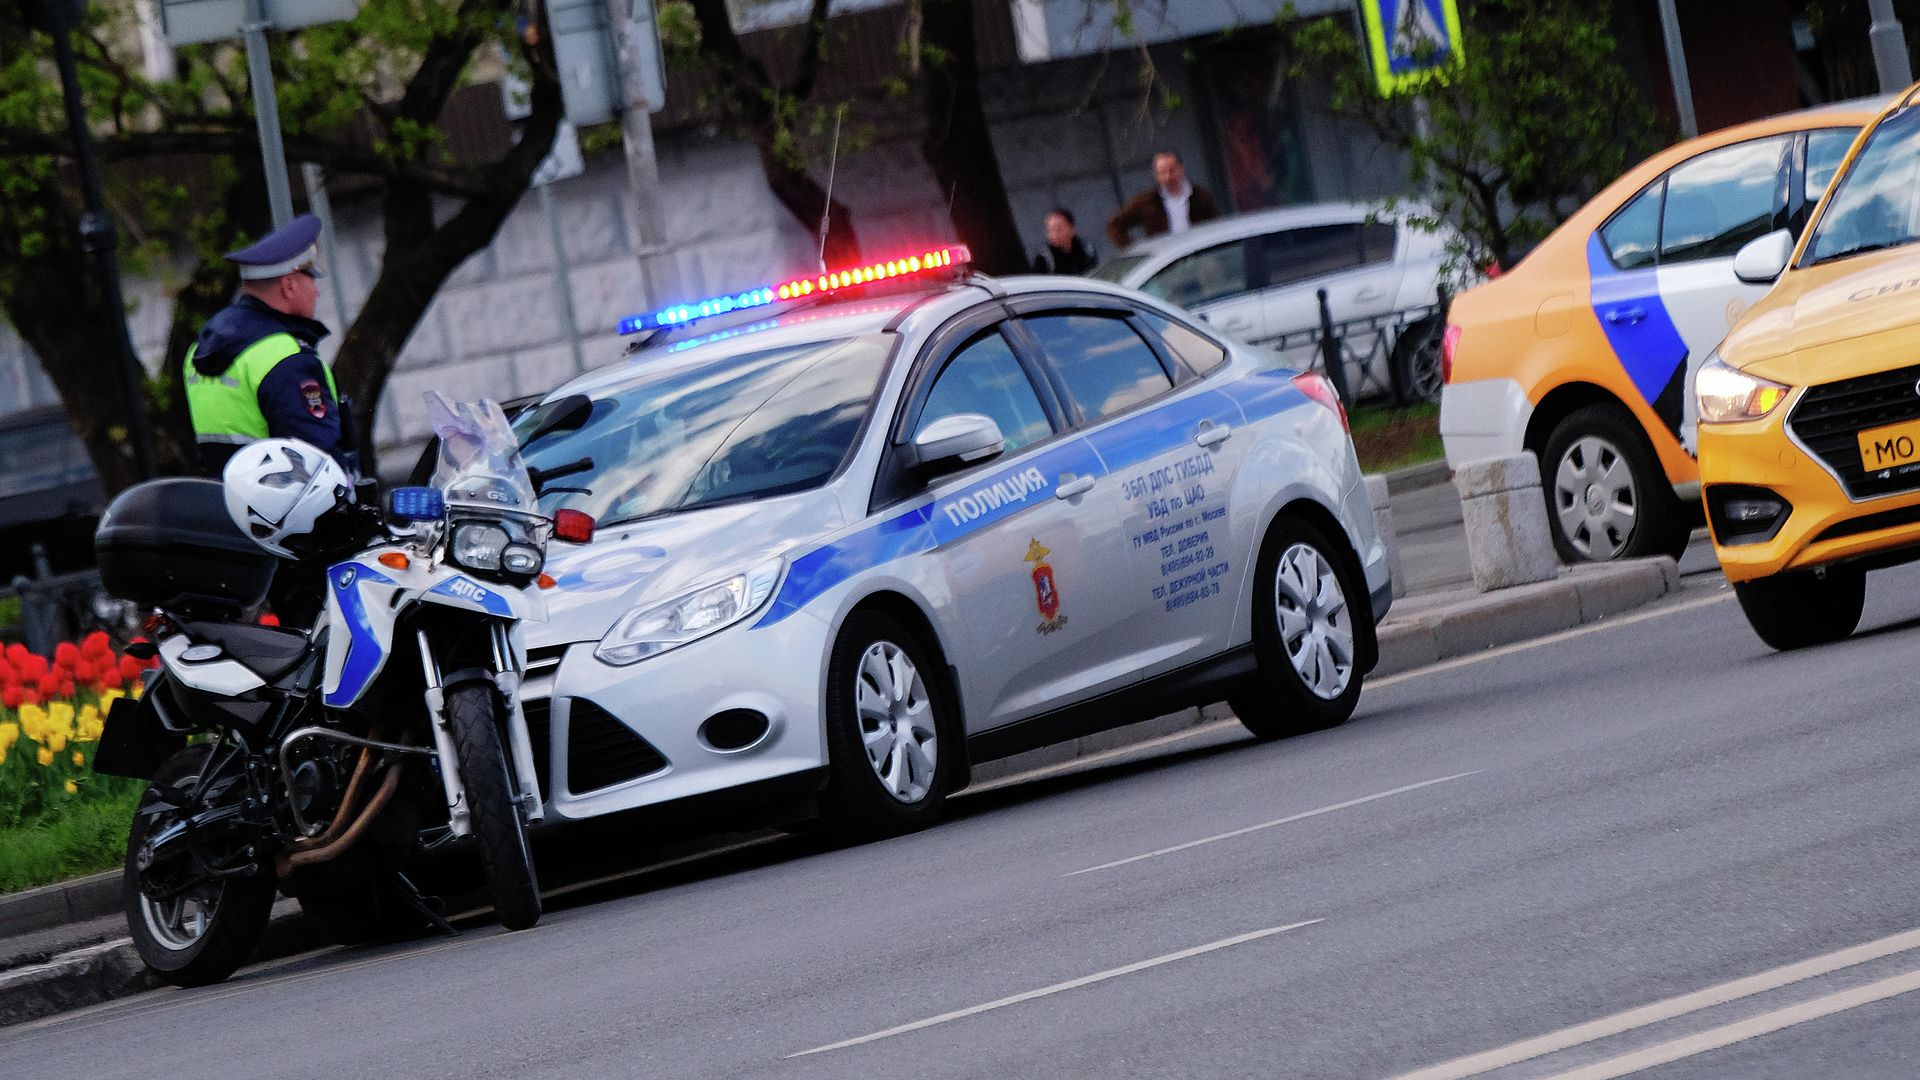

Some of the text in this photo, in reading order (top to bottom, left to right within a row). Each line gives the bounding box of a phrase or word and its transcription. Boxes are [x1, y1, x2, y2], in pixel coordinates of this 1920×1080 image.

[1149, 466, 1174, 494] ДПС
[1174, 453, 1215, 482] ГИБДД
[487, 490, 508, 502] GS
[943, 466, 1049, 527] ПОЛИЦИЯ
[1146, 484, 1205, 519] УВД по ЦАО
[449, 579, 487, 602] ДПС
